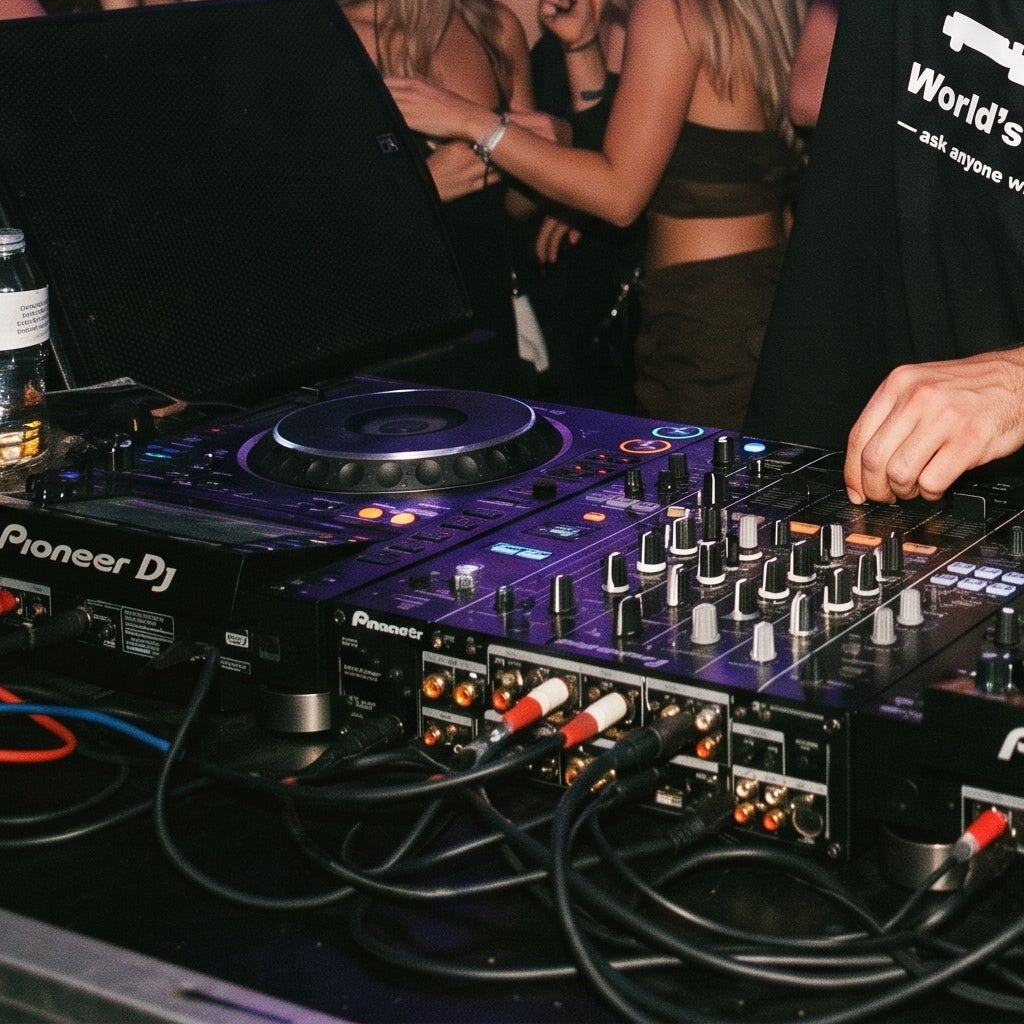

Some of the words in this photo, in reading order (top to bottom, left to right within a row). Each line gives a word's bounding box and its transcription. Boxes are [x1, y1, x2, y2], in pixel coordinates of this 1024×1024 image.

[907, 61, 1024, 147] World's
[949, 146, 1003, 184] anyone
[0, 524, 131, 574] Pioneer
